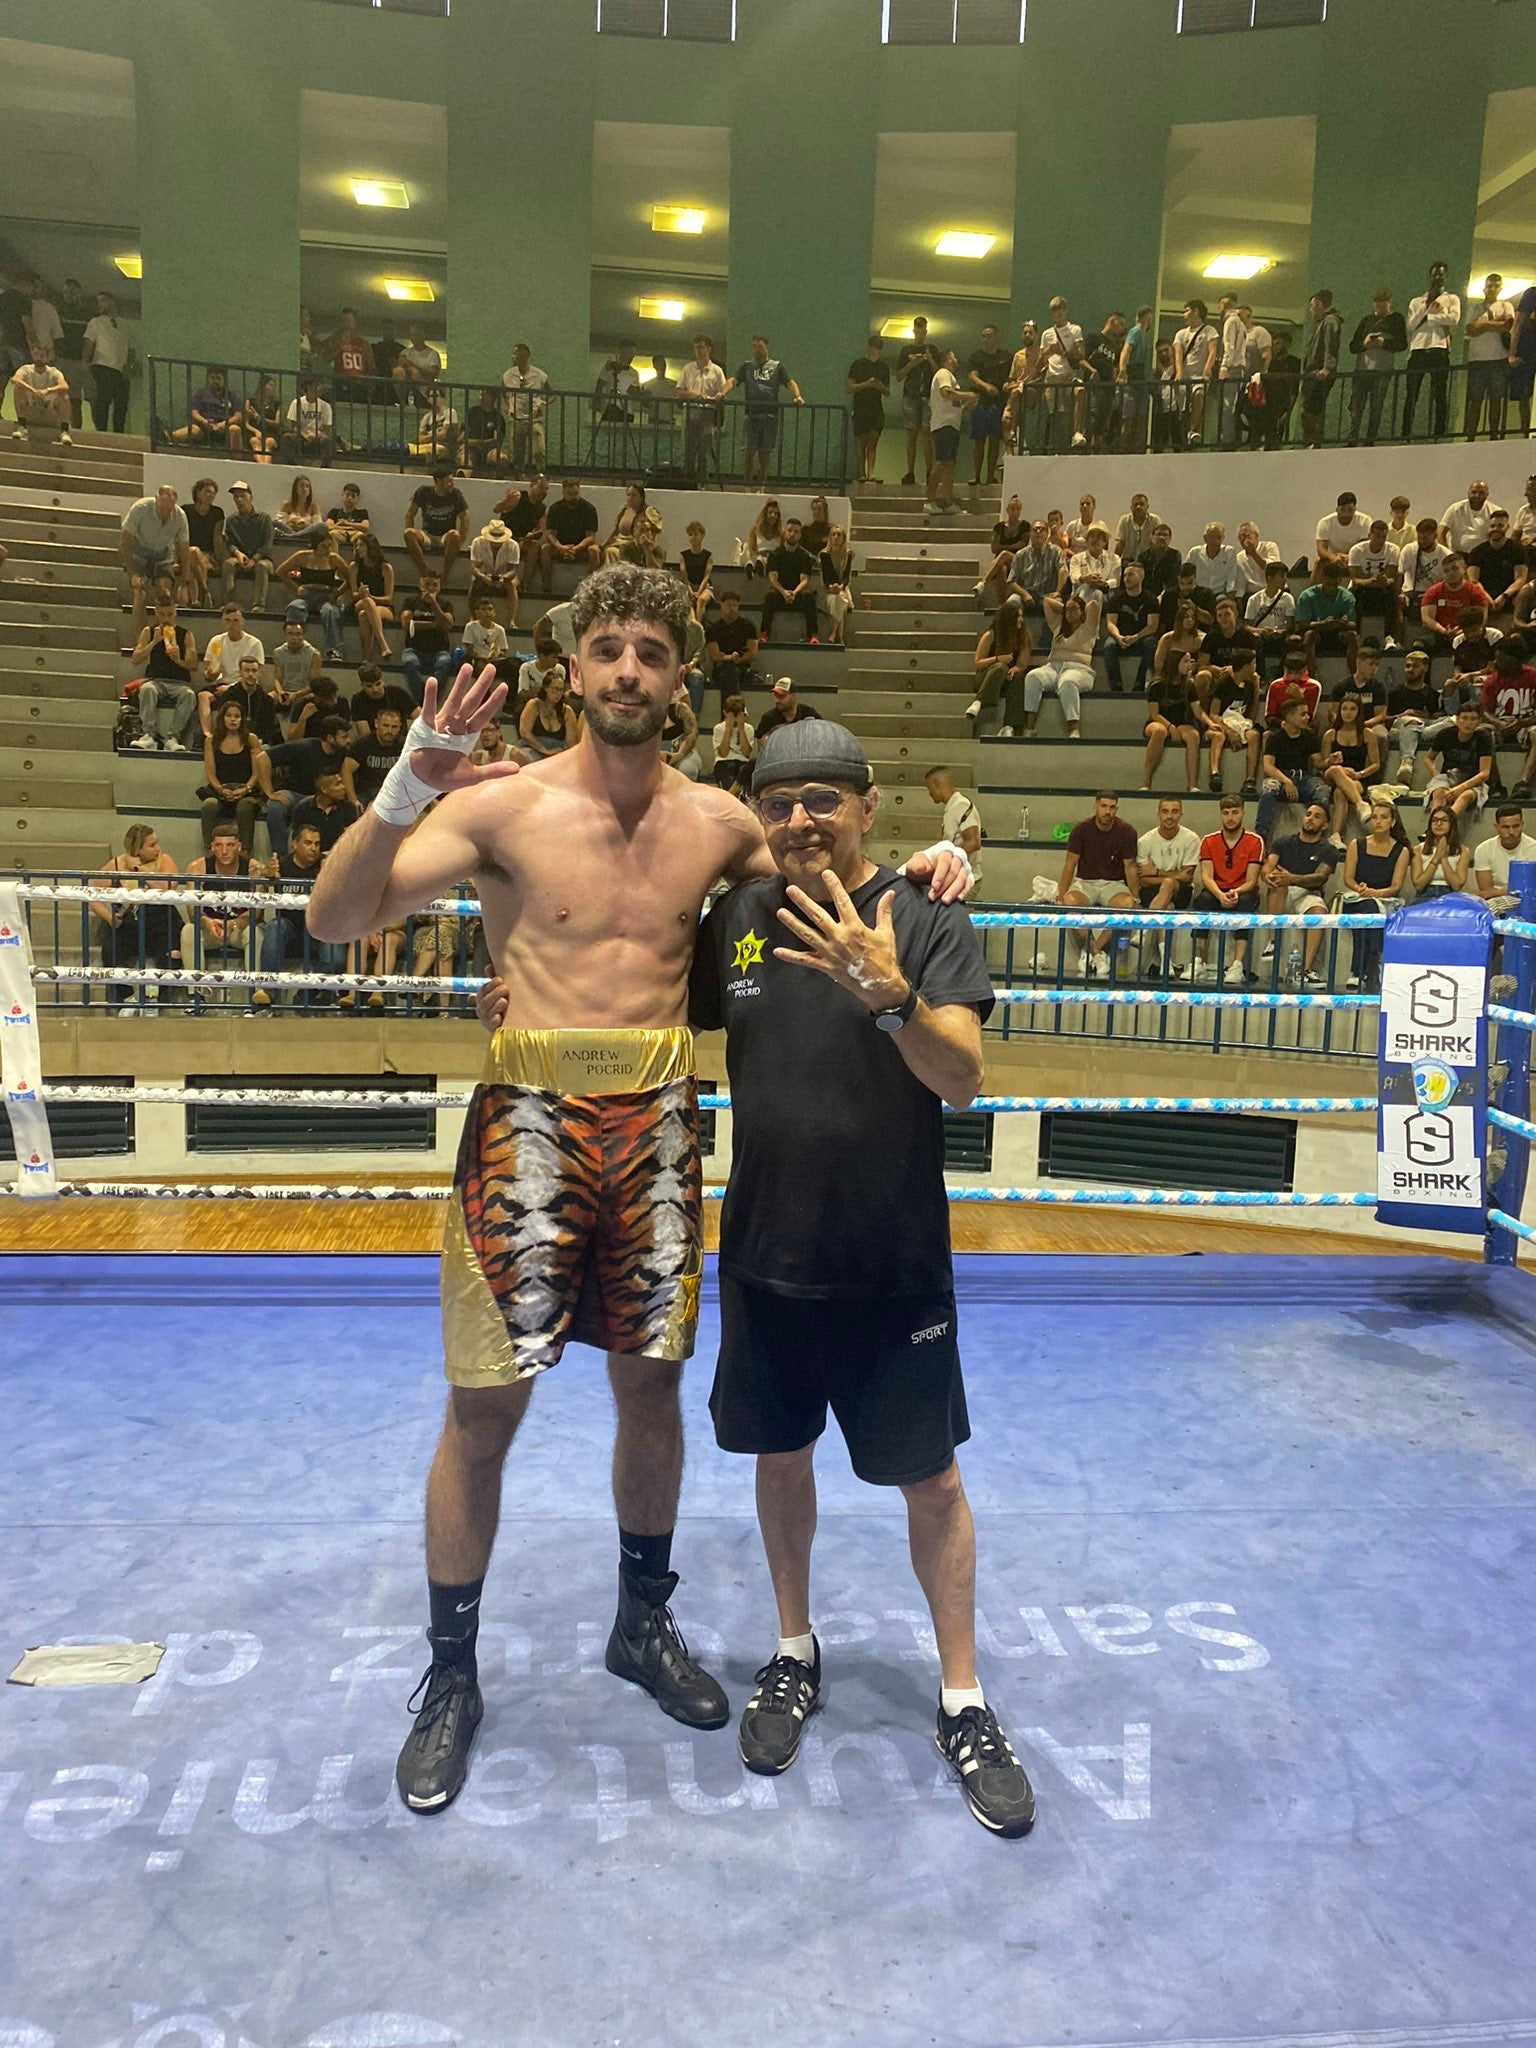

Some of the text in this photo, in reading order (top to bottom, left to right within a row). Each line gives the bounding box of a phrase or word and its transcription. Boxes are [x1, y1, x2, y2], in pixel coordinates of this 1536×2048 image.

[342, 351, 363, 370] 60
[726, 977, 755, 992] ANDREW
[734, 986, 761, 998] POCRID
[1395, 1033, 1473, 1053] SHARK
[562, 1049, 620, 1062] ANDREW
[1394, 1050, 1474, 1061] BOXING
[586, 1063, 633, 1076] POCRID
[1393, 1171, 1472, 1192] SHARK
[1393, 1188, 1473, 1199] BOXING
[911, 1320, 950, 1345] SPORT
[55, 1629, 263, 1717] d
